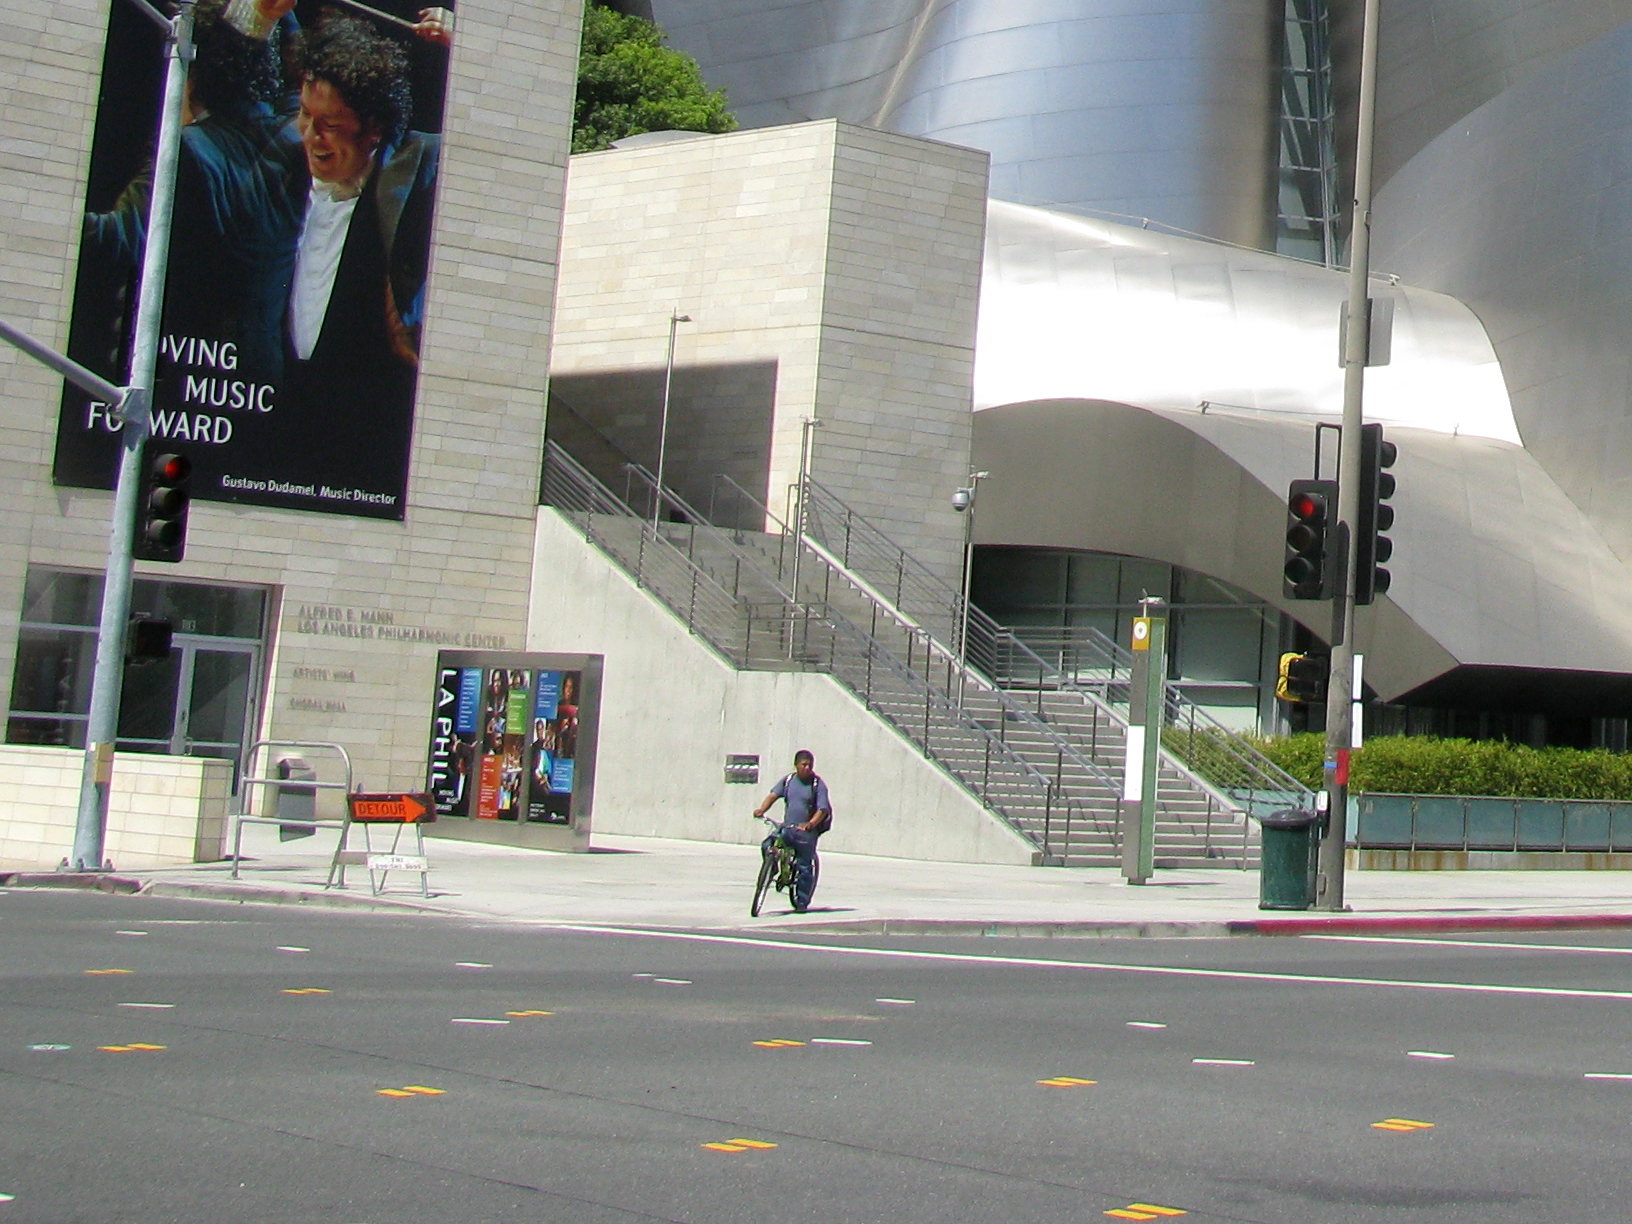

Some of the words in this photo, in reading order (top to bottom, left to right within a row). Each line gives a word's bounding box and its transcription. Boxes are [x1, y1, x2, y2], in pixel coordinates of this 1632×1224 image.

[161, 334, 238, 370] VING
[184, 375, 275, 413] MUSIC
[88, 401, 233, 444] FOWARD
[222, 474, 266, 491] Gustavo
[319, 485, 352, 500] Music
[353, 490, 397, 505] Director
[438, 668, 458, 708] LA
[430, 716, 453, 789] PHIL
[357, 803, 406, 816] DETOUR
